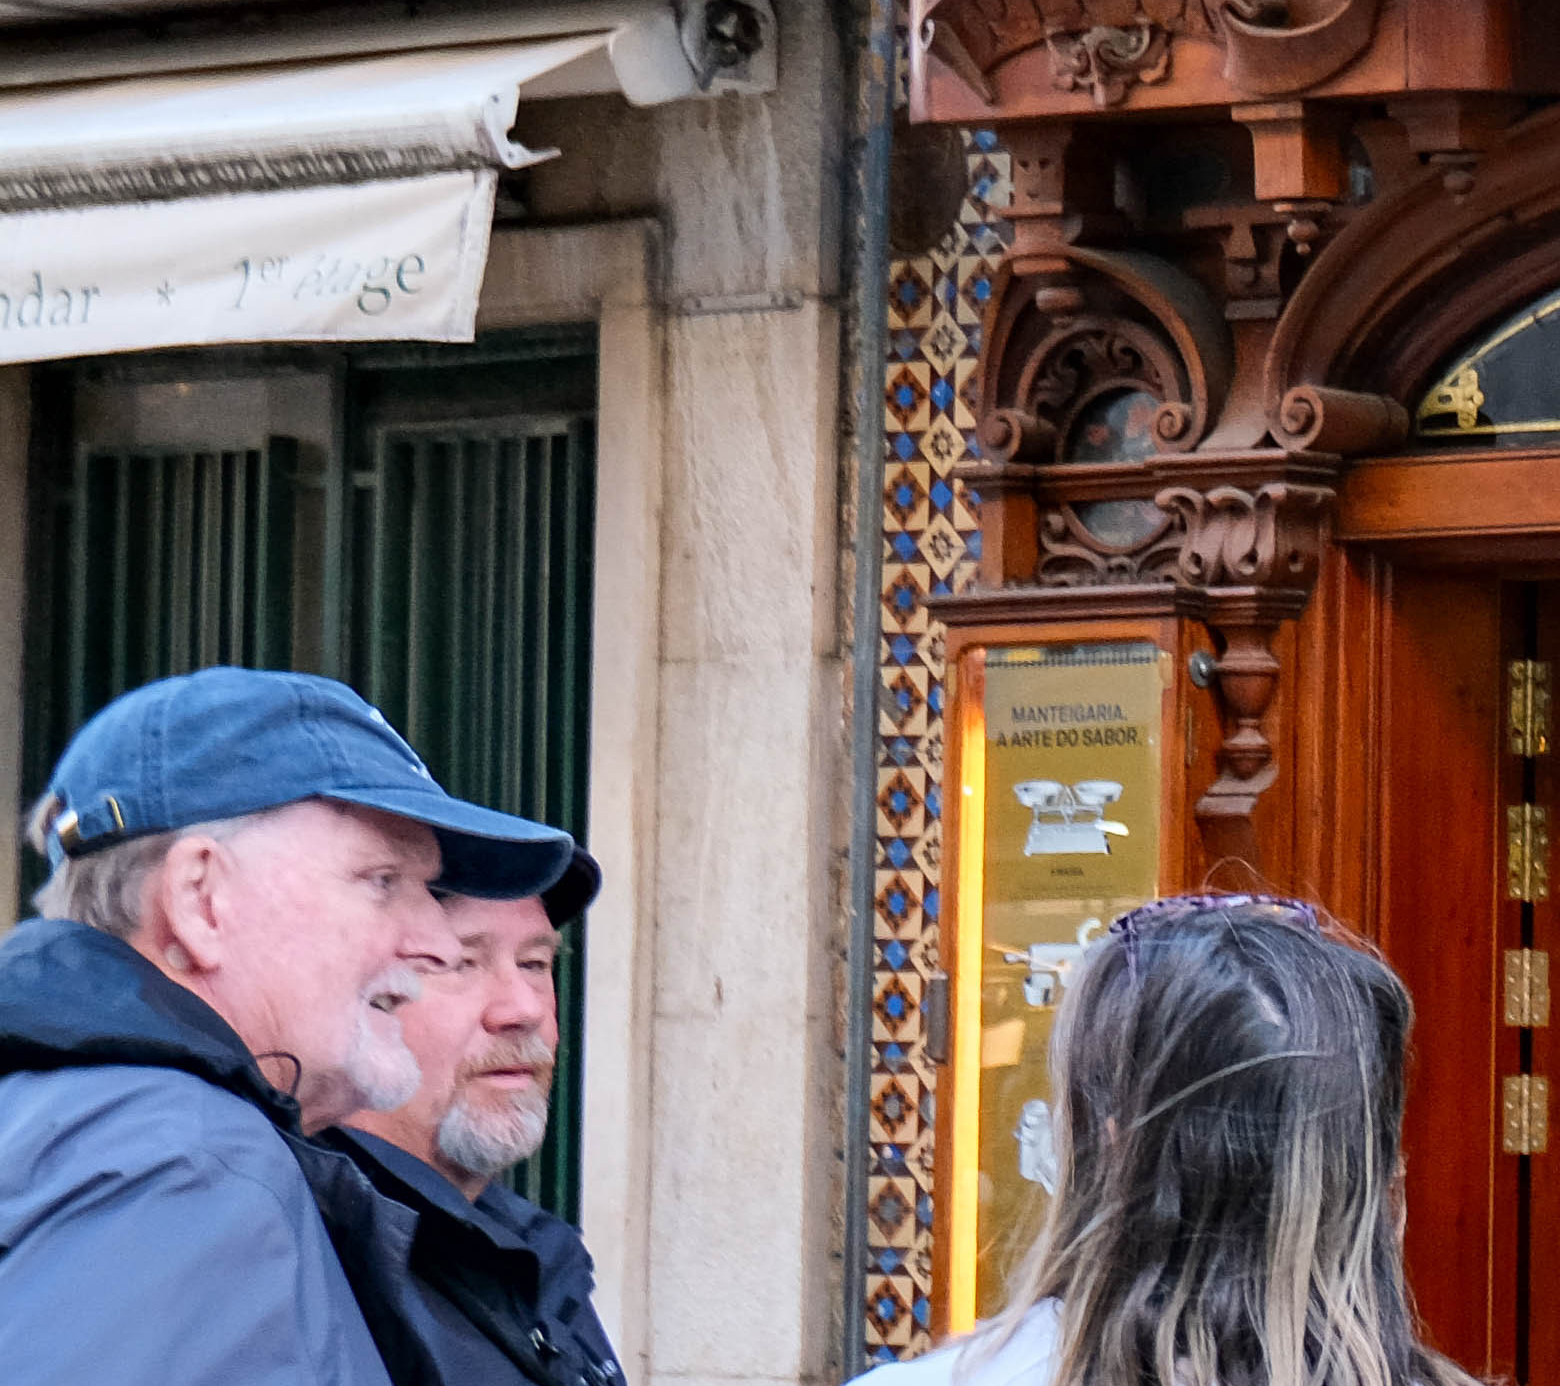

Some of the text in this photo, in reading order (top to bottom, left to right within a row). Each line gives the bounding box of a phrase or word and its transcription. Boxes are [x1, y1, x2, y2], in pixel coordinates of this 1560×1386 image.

[1011, 703, 1128, 725] MANTEIGARIA.
[996, 726, 1143, 748] A ARTE DO SABOR.
